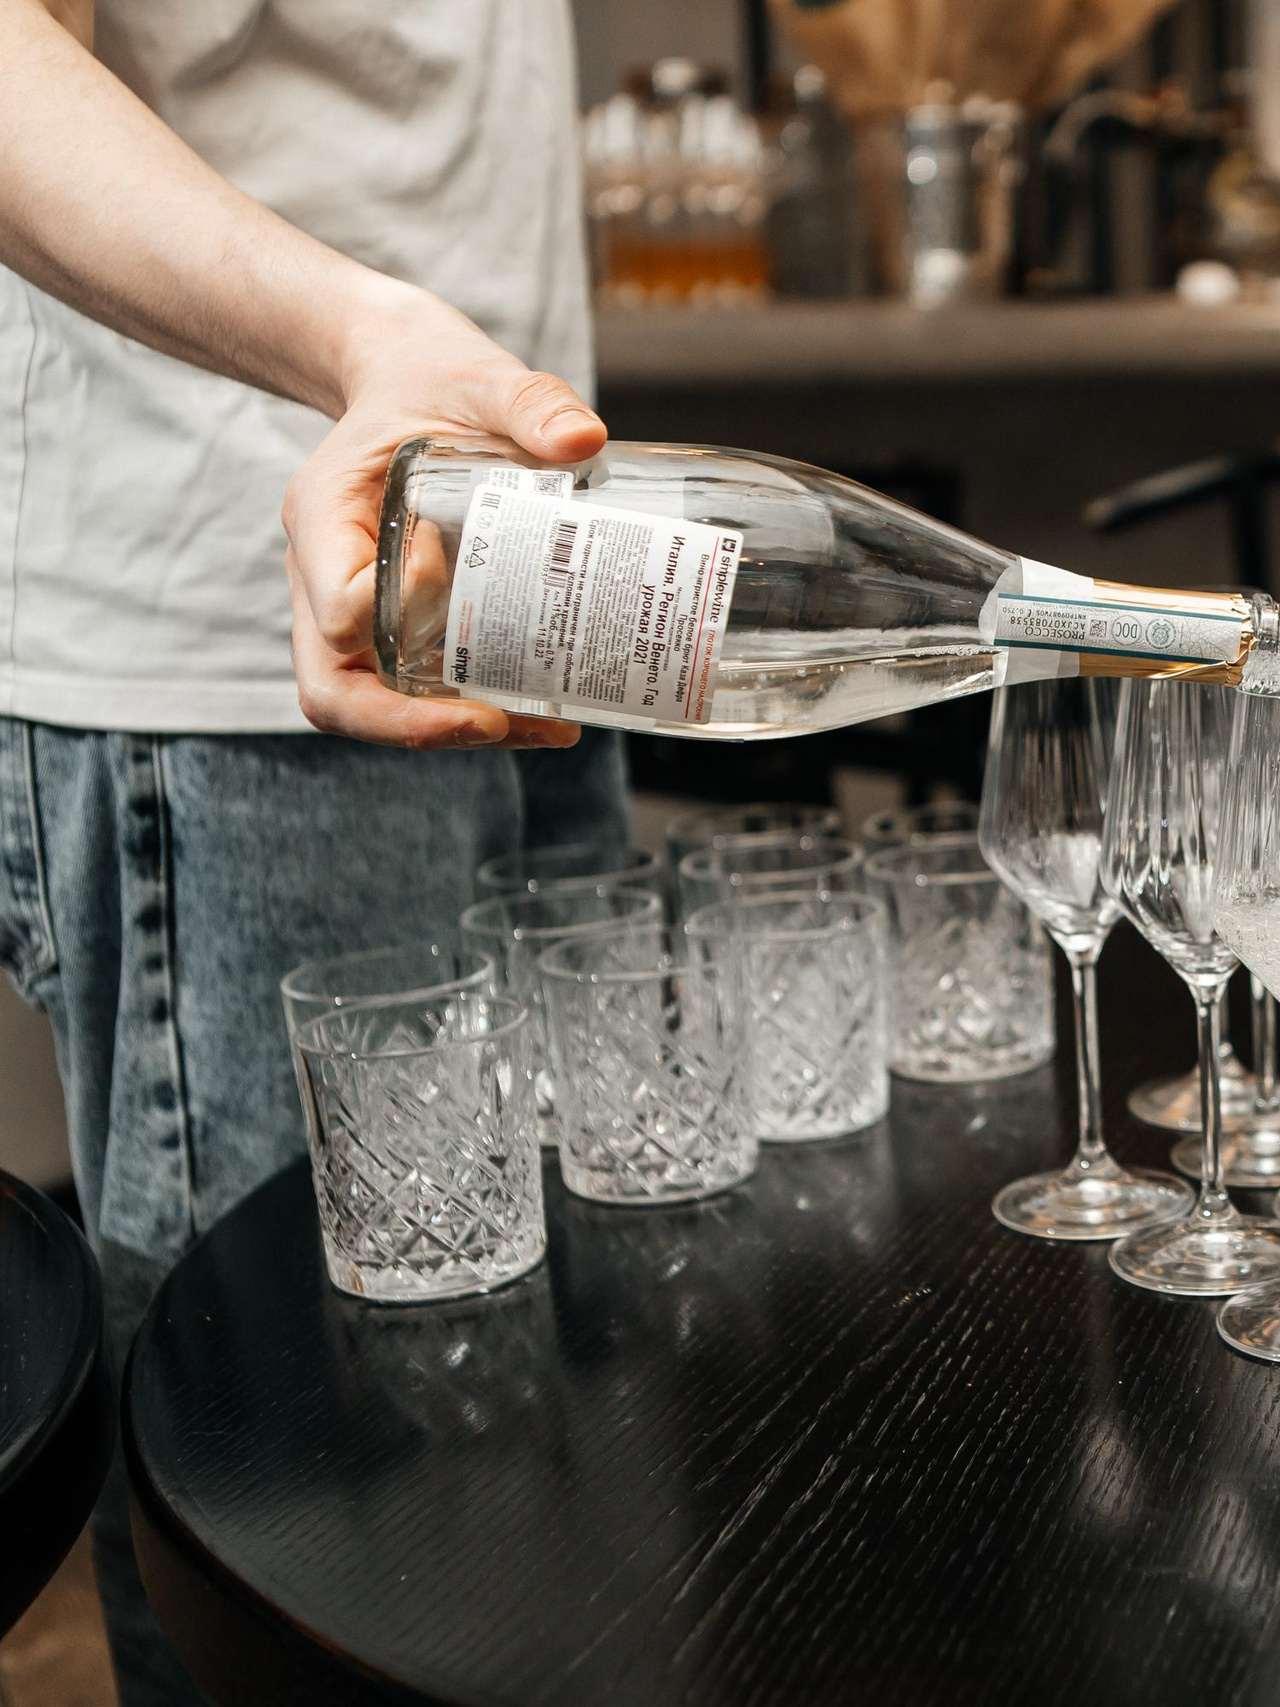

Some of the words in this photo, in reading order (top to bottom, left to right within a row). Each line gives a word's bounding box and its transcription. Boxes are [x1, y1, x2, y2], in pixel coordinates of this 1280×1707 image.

[587, 519, 598, 538] Срок
[579, 539, 593, 578] годности
[663, 535, 685, 588] Италия.
[697, 553, 709, 576] Вино
[563, 570, 575, 607] условий
[576, 580, 584, 591] не
[709, 555, 732, 624] simplewine
[568, 592, 582, 635] ограничен
[637, 583, 657, 634] урожая
[652, 591, 674, 639] Регион
[1002, 606, 1024, 615] 0.750
[671, 613, 687, 651] Просекко
[684, 616, 697, 641] белое
[1024, 626, 1086, 640] PROSECCO
[1115, 622, 1137, 638] DOC
[565, 636, 575, 651] при
[632, 637, 649, 664] 2021
[679, 642, 693, 663] брют
[451, 646, 471, 683] simple
[644, 642, 665, 686] Венето.
[678, 664, 689, 681] Каза
[641, 687, 658, 706] Год
